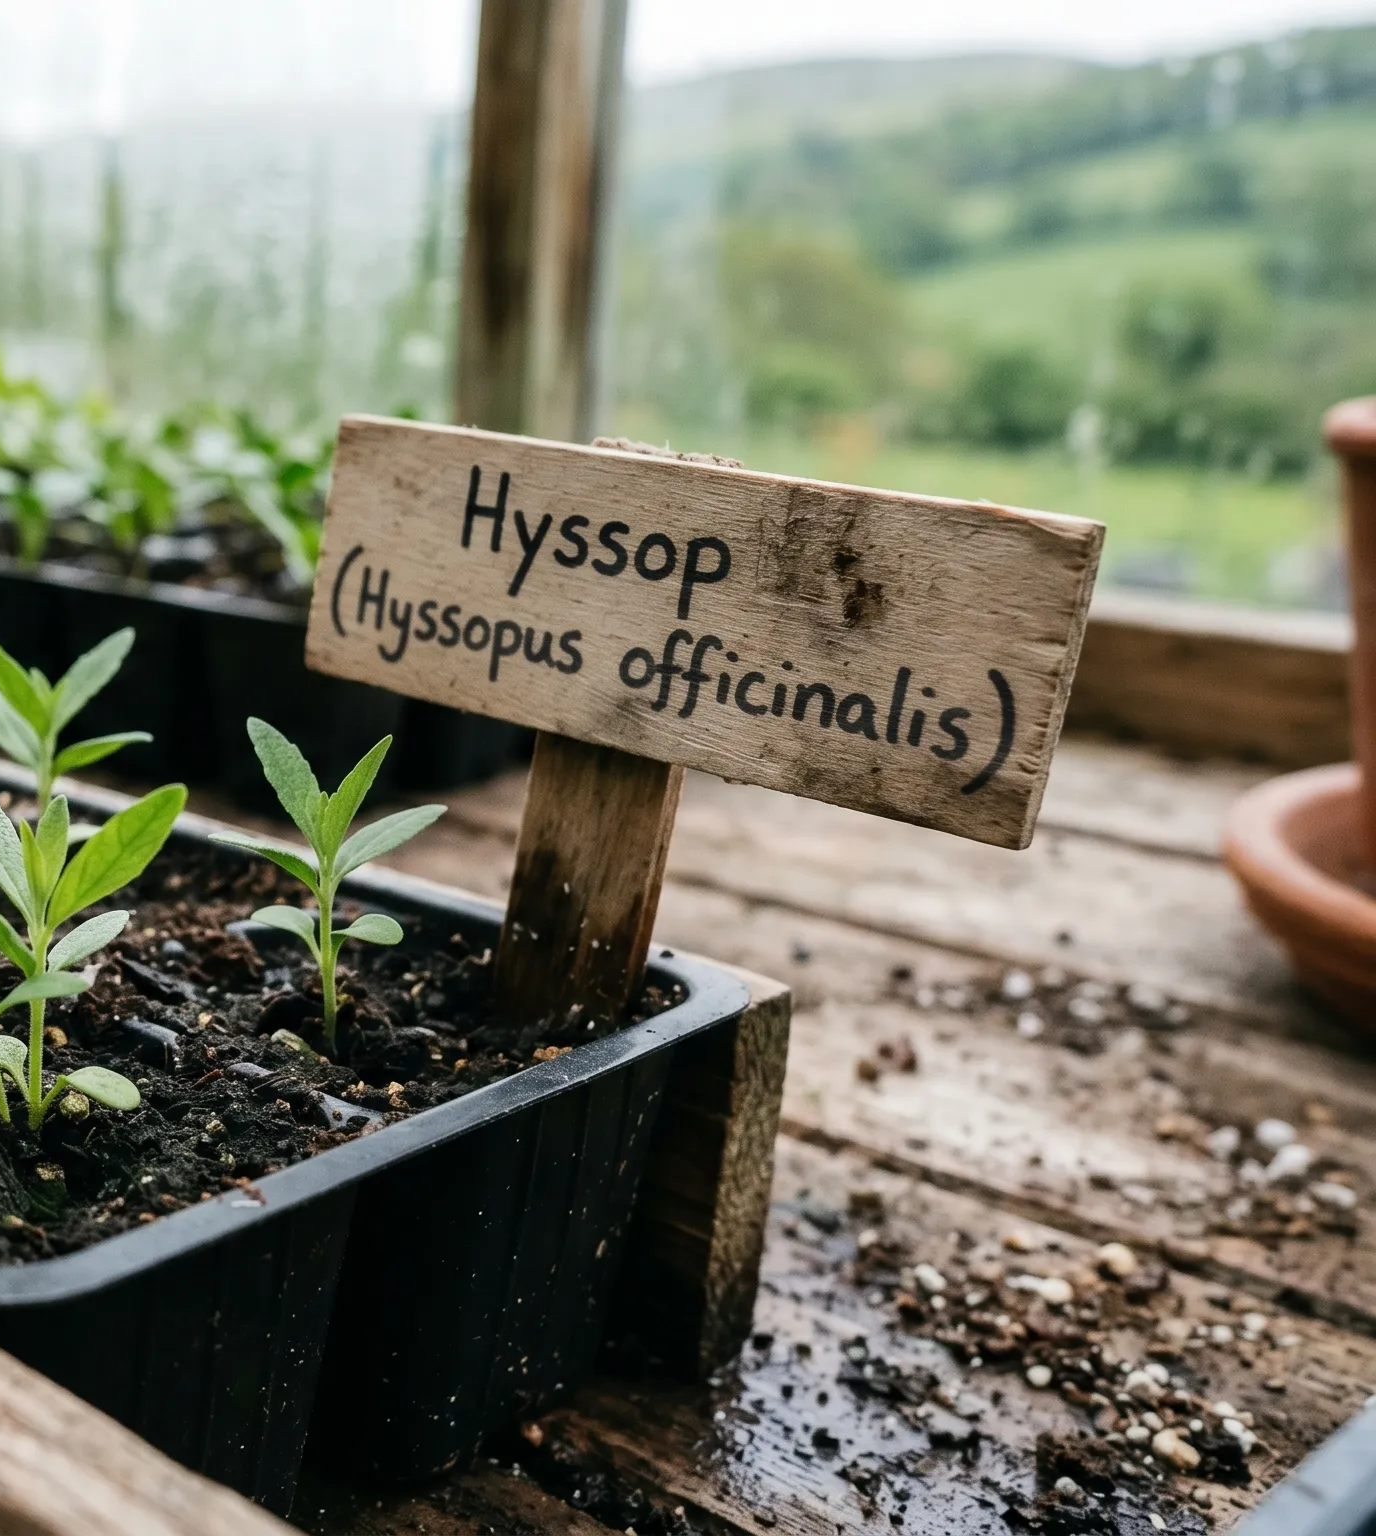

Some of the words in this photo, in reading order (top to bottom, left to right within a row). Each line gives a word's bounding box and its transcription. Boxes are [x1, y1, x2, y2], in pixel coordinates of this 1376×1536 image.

[461, 465, 732, 620] Hyssop
[330, 545, 584, 682] (Hyssopus
[619, 628, 1016, 795] officinalis)
